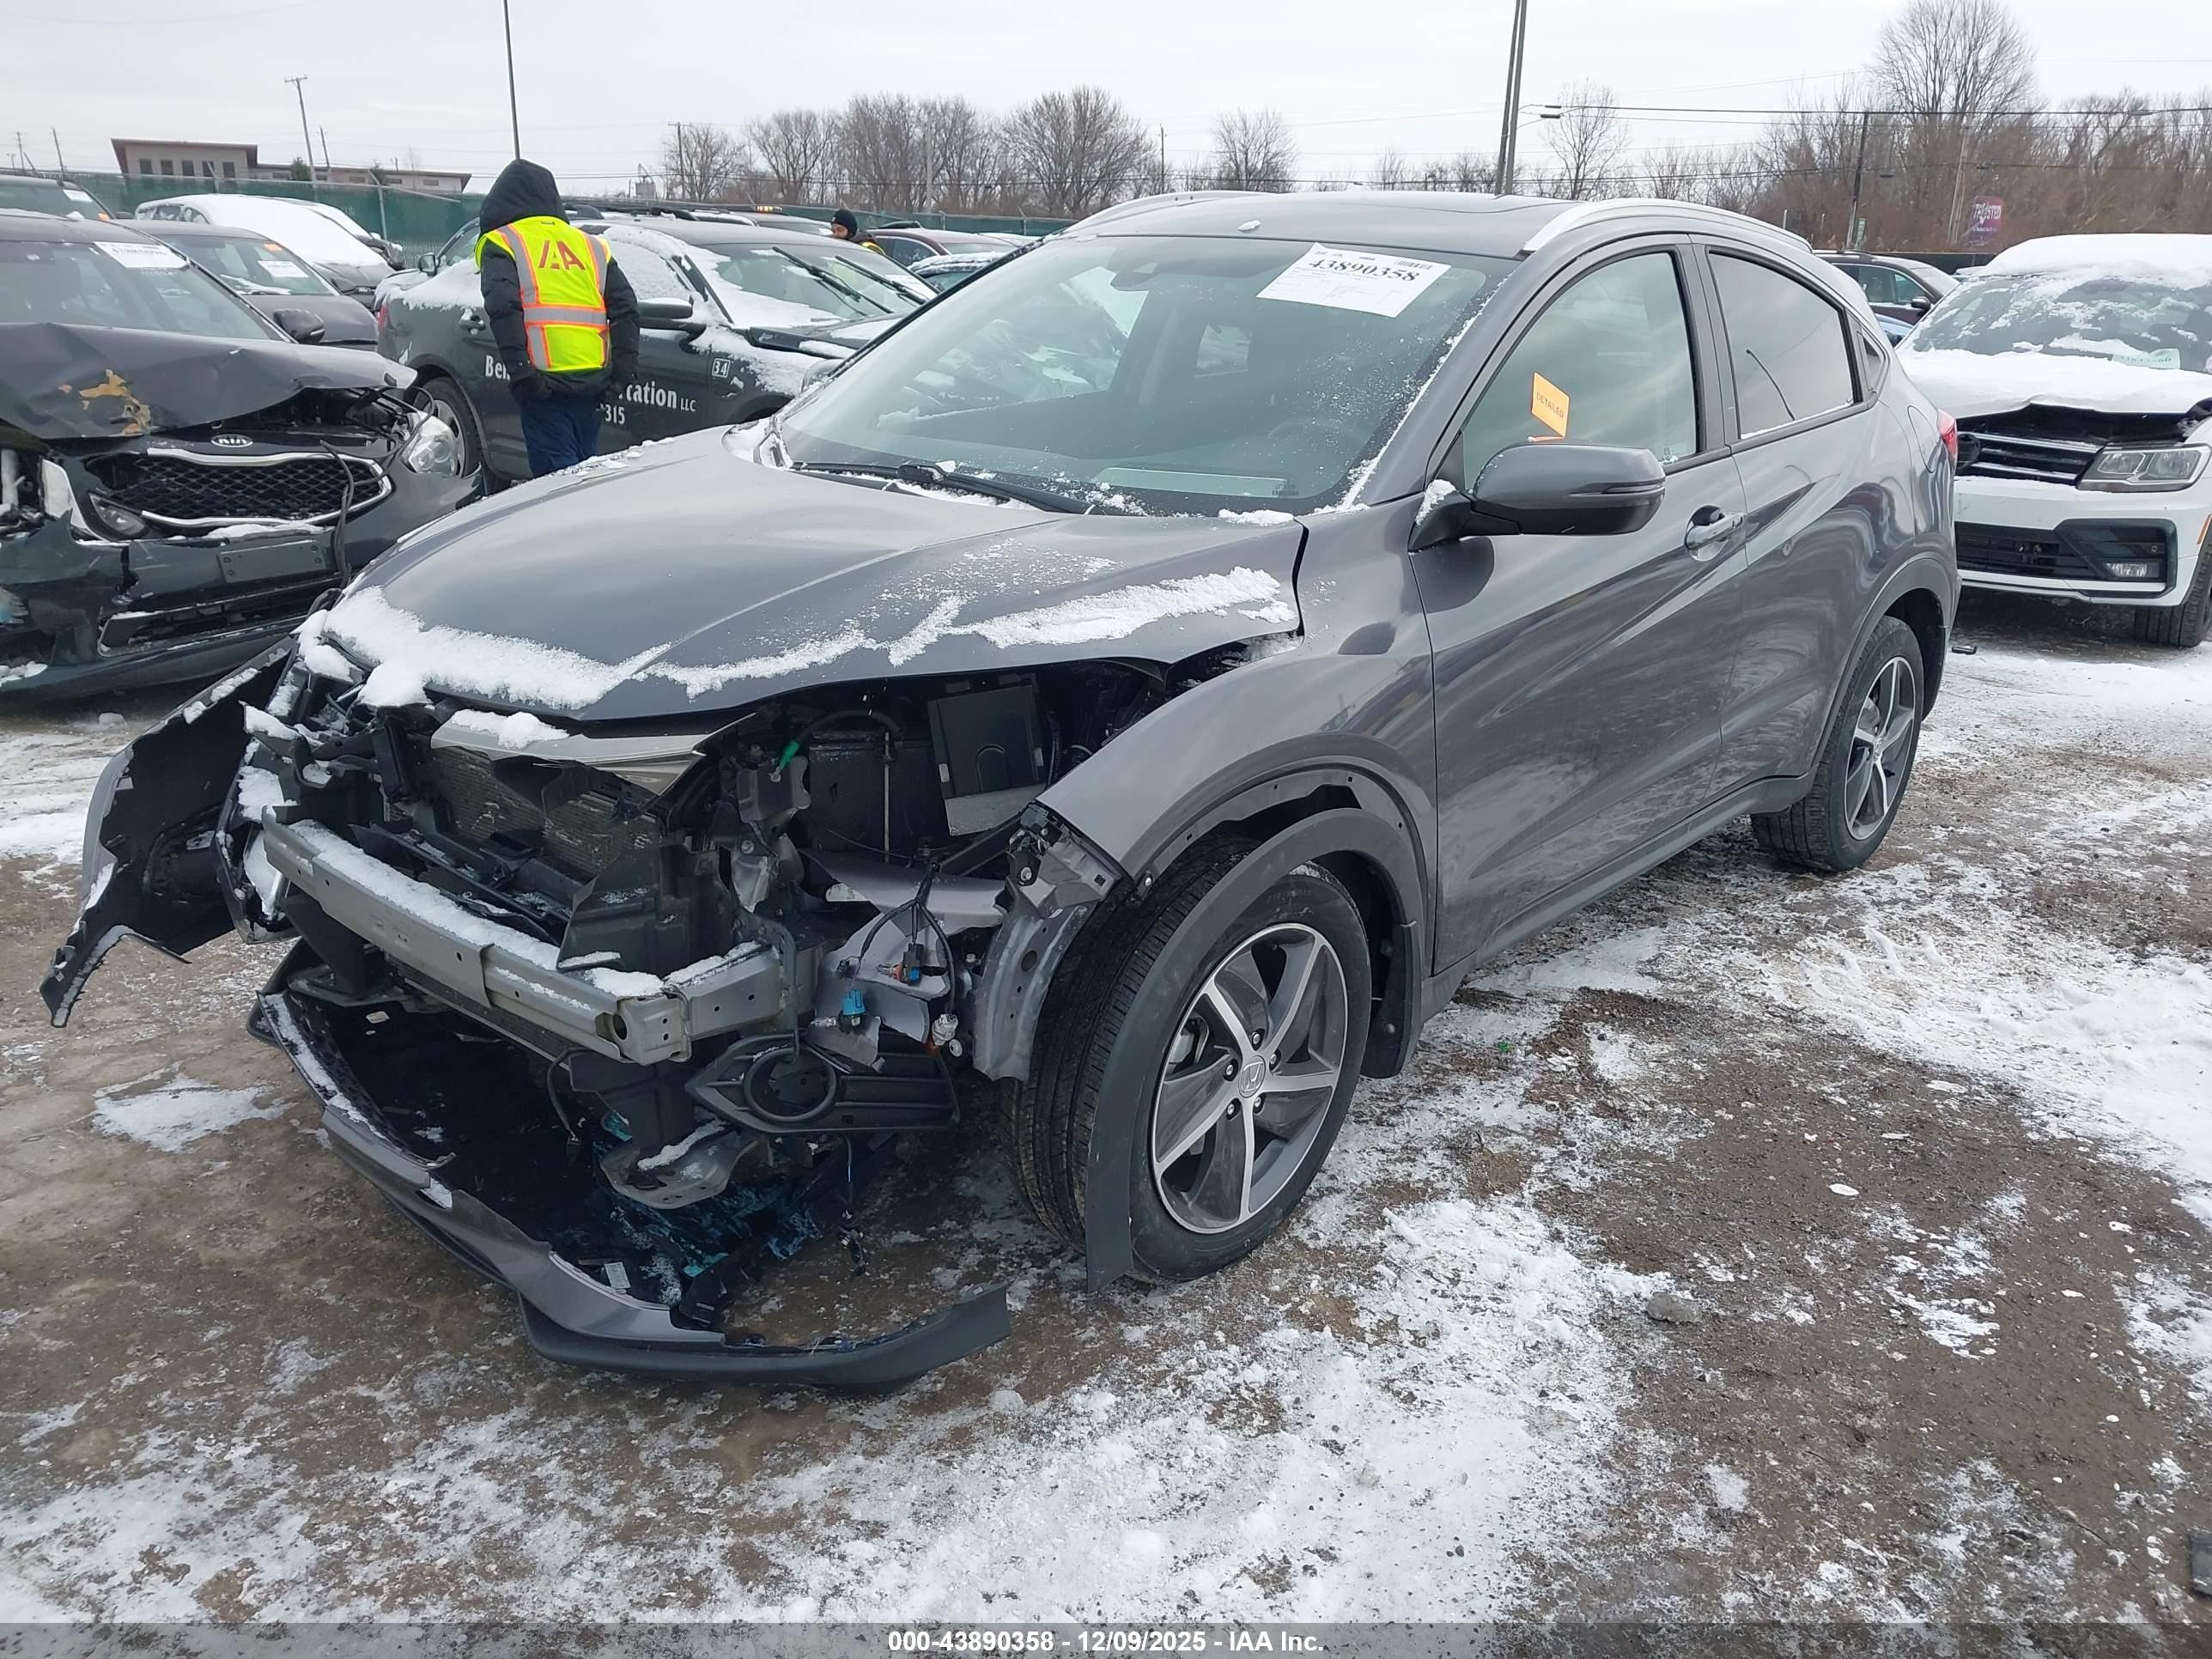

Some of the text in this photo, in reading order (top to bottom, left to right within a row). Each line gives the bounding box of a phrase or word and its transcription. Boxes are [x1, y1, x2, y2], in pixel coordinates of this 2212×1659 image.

[1309, 258, 1420, 282] 43890358
[714, 361, 728, 376] 34
[617, 380, 678, 409] cation
[680, 398, 696, 412] LLC
[1536, 391, 1565, 418] DETAILED
